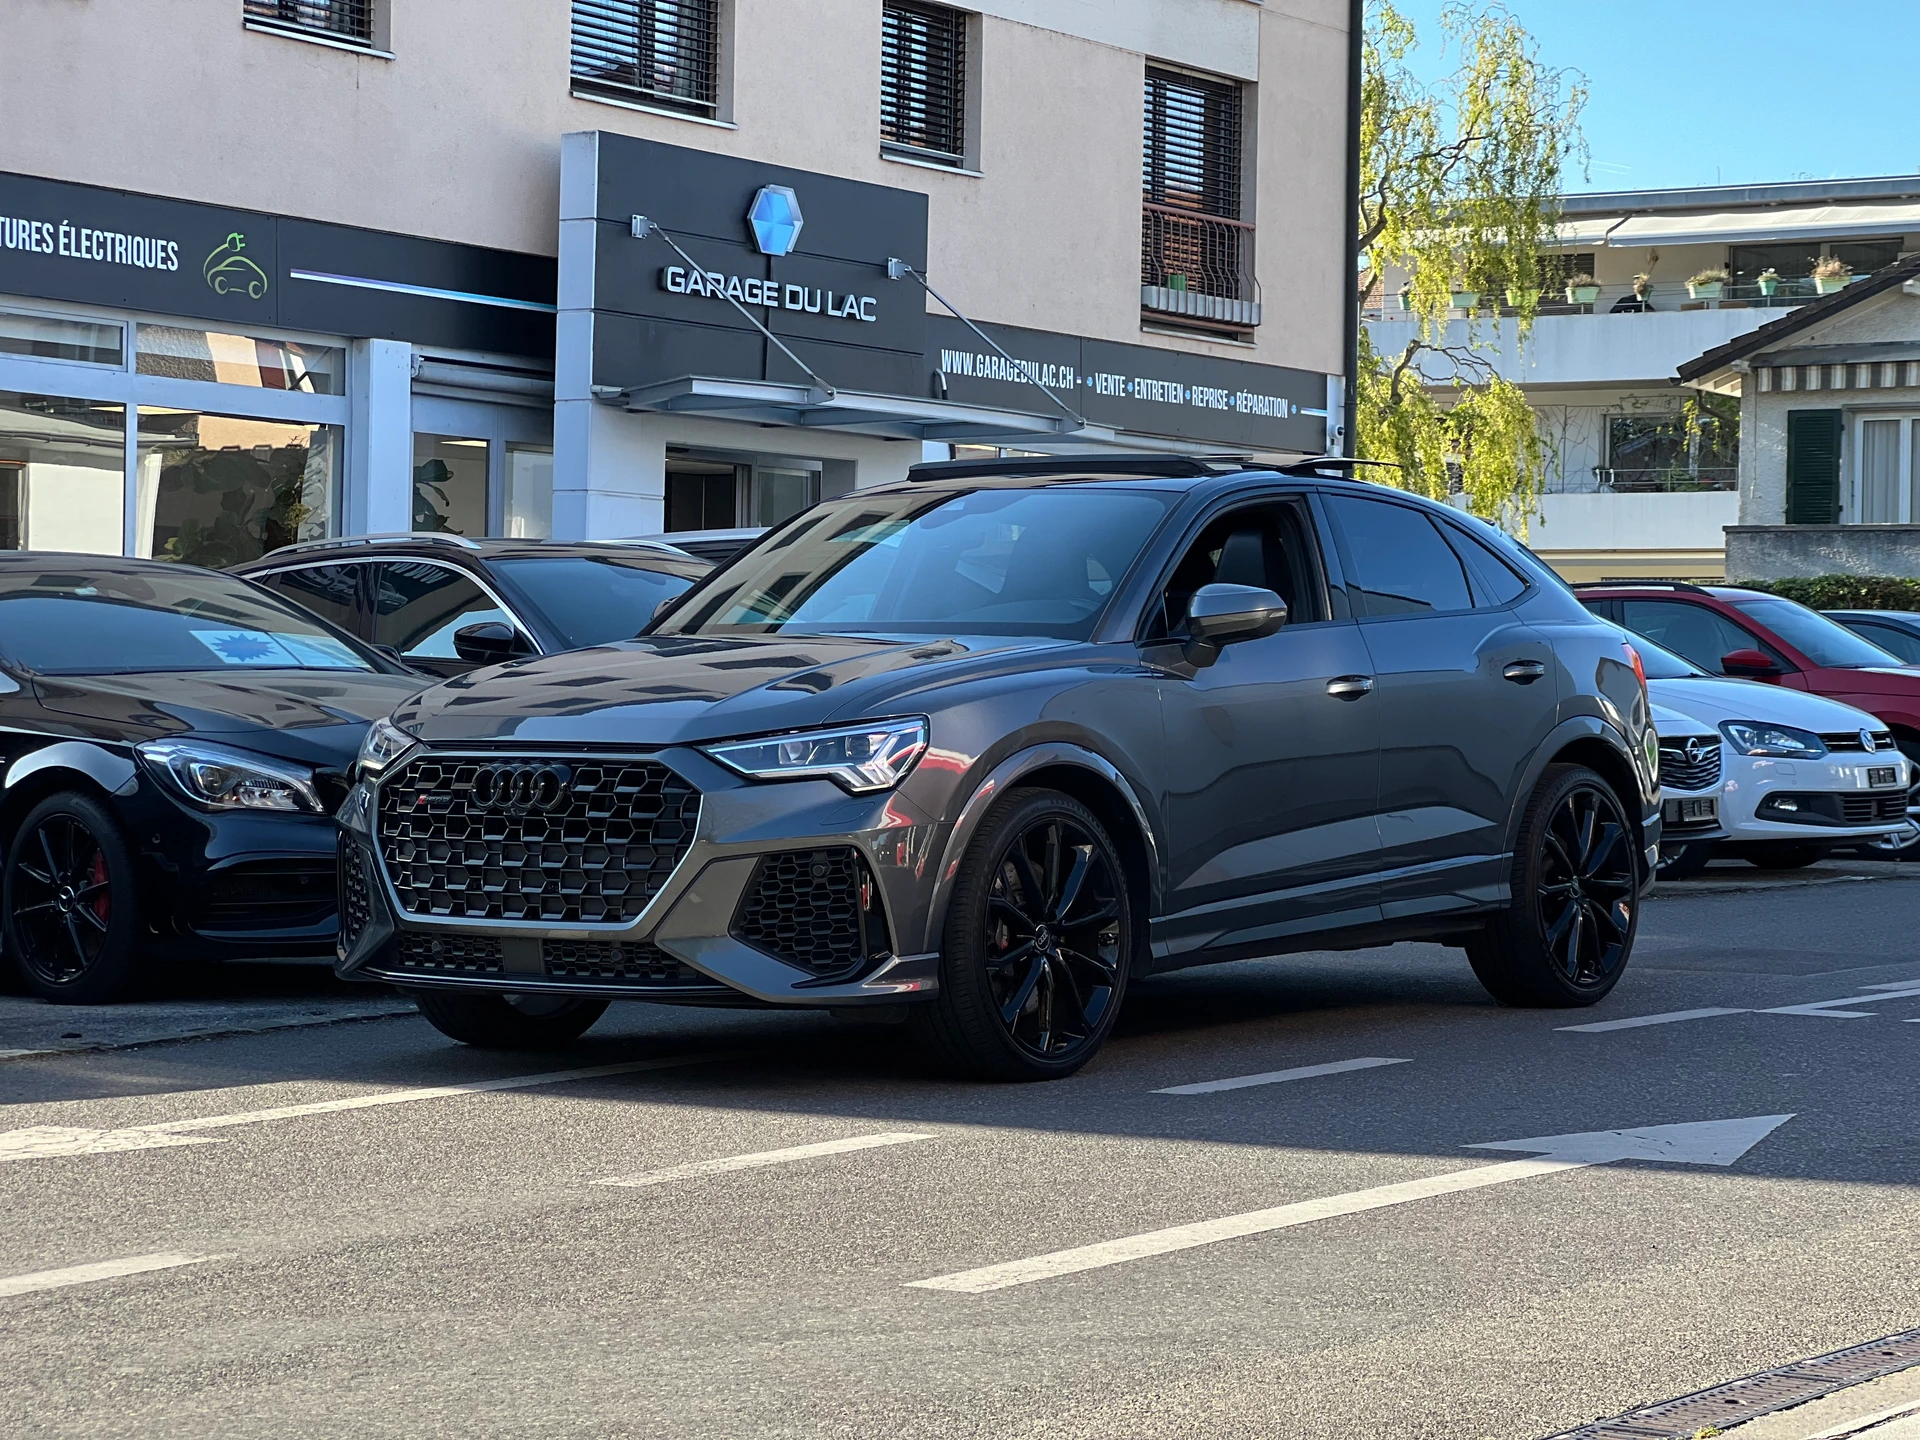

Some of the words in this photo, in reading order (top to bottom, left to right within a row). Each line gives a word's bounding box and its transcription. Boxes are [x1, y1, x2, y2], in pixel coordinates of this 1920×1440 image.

[59, 219, 179, 271] ÉLECTRIQUES
[665, 266, 779, 307] GARAGE
[785, 283, 821, 313] DU
[827, 290, 877, 322] LAC
[941, 348, 1074, 389] WWW.GARAGEDULAC.CH
[1095, 372, 1126, 397] VENTE
[1134, 377, 1184, 405] ENTRETIEN
[1192, 385, 1229, 410] REPRISE
[1236, 388, 1288, 418] RÉPARATION
